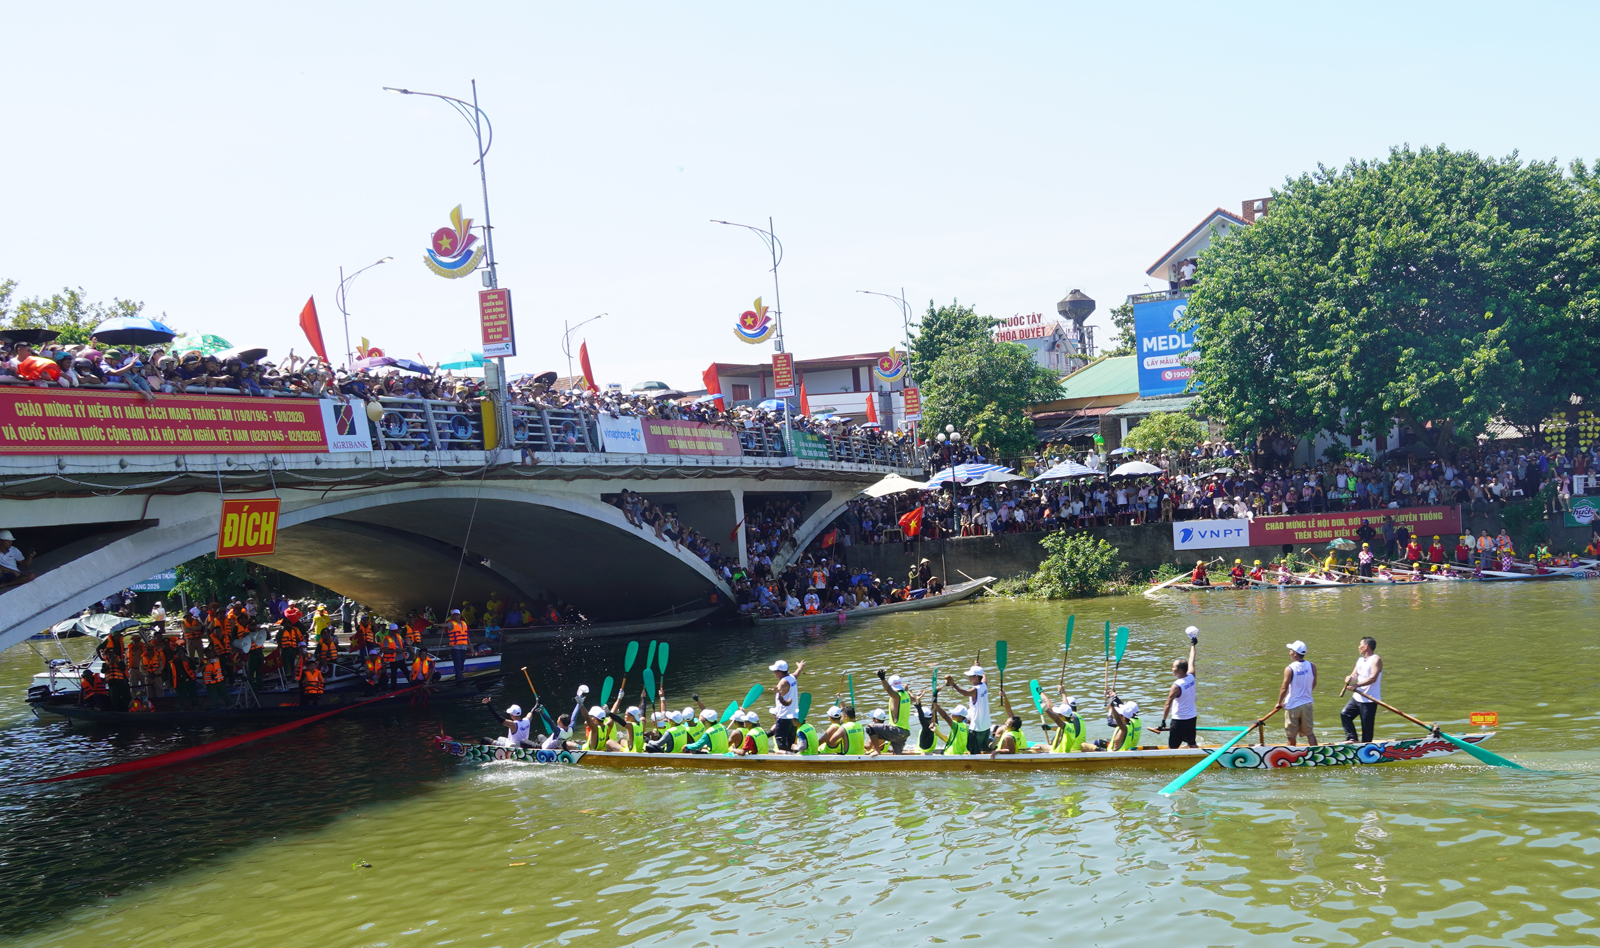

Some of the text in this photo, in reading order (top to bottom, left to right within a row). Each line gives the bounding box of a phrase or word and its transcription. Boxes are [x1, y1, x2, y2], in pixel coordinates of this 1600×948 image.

[1026, 312, 1042, 324] TÂY
[1146, 357, 1158, 366] LẤY
[14, 400, 42, 416] CHÀO
[43, 400, 73, 417] MỪNG
[73, 400, 86, 418] KỶ
[87, 402, 112, 421] NIỆM
[112, 406, 123, 418] 81
[124, 404, 145, 419] NĂM
[145, 404, 168, 419] CÁCH
[168, 407, 192, 422] MẠNG
[191, 406, 217, 420] THÁNG
[216, 406, 233, 421] TÁM
[234, 409, 268, 422] (19/8/1945
[2, 423, 18, 440] VÀ
[18, 422, 46, 442] QUỐC
[46, 424, 80, 440] KHÁNH
[80, 425, 105, 441] NƯỚC
[106, 425, 131, 443] CỘNG
[131, 426, 149, 441] HOÀ
[149, 426, 162, 441] XÃ
[161, 426, 176, 443] HỘI
[177, 425, 192, 441] CHỦ
[193, 427, 216, 441] NGHĨA
[216, 427, 232, 443] VIỆT
[232, 430, 249, 441] NAM
[604, 428, 630, 440] vinaphone
[333, 441, 368, 449] AGRIBANK
[1265, 521, 1284, 530] CHÀO
[1286, 520, 1306, 529] MỪNG
[1308, 518, 1315, 528] LỄ
[1317, 519, 1329, 528] HỘI
[1419, 510, 1443, 520] THỐNG
[224, 505, 275, 548] ĐÍCH
[1198, 528, 1243, 539] VNPT
[1294, 530, 1312, 539] TRÊN
[1314, 530, 1332, 538] SÔNG
[1334, 527, 1350, 537] KIẾN
